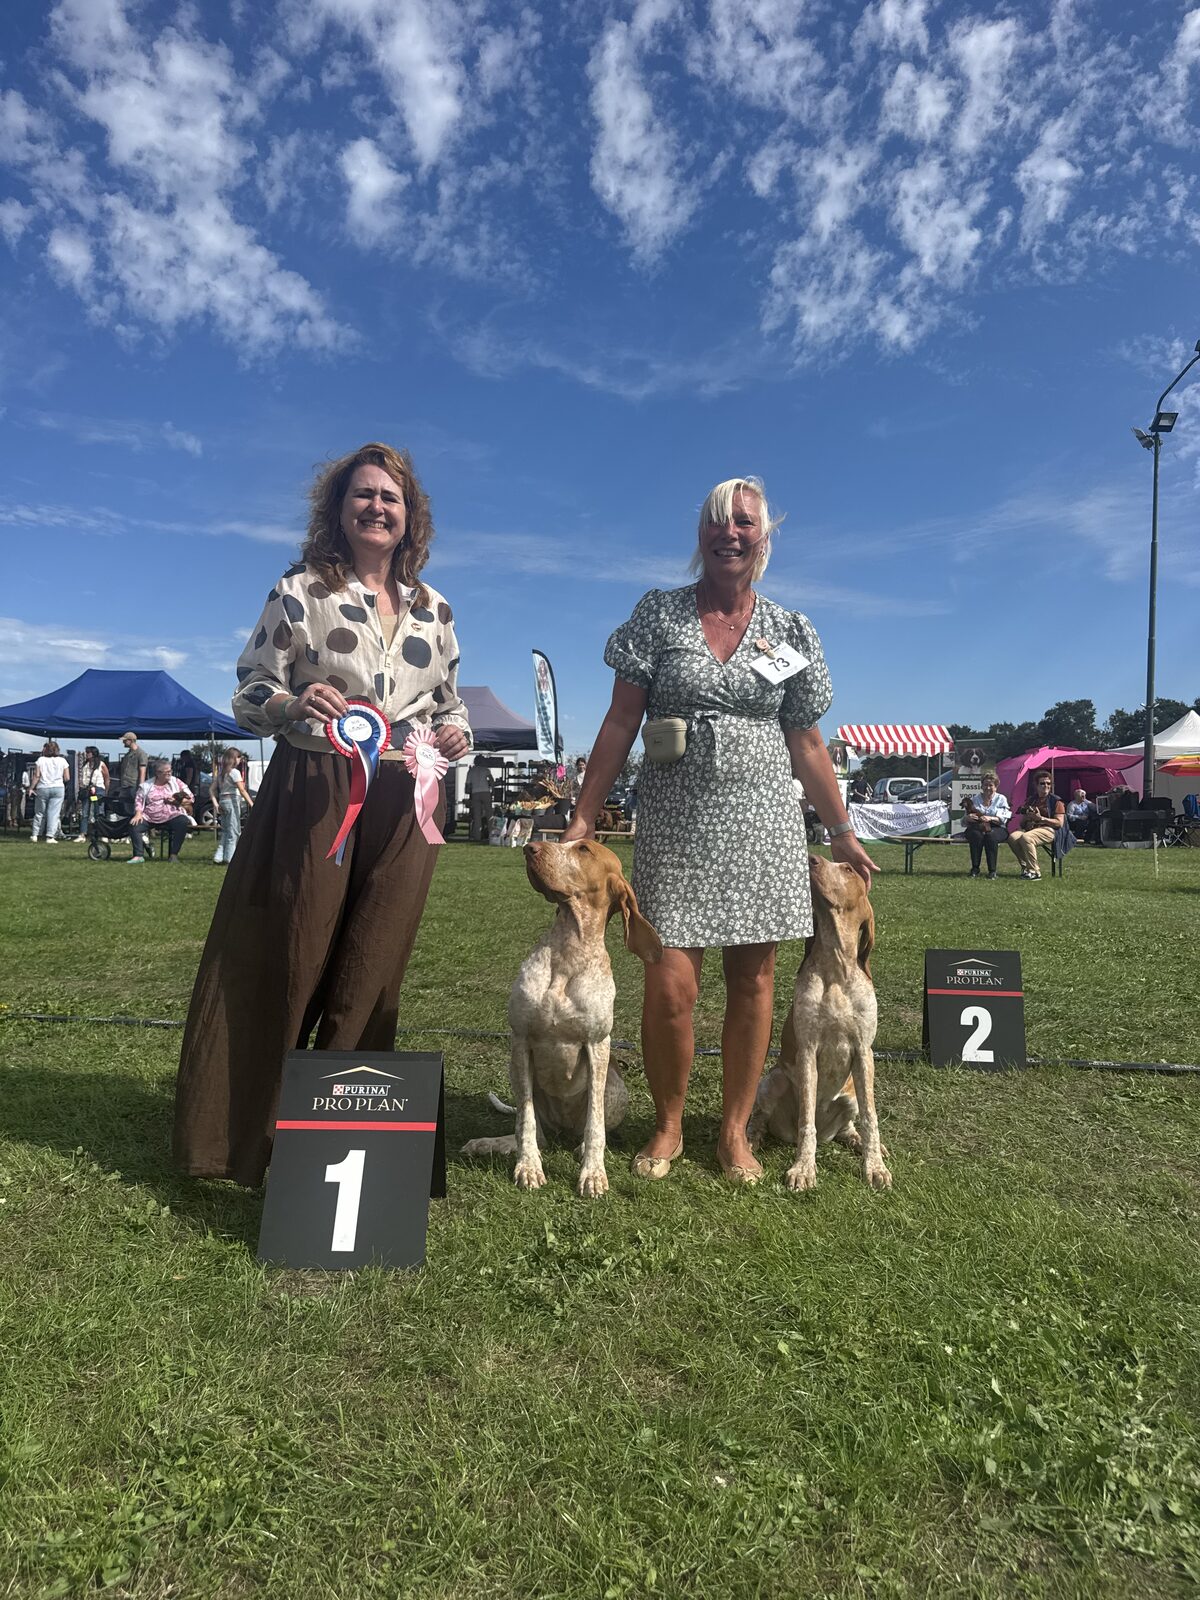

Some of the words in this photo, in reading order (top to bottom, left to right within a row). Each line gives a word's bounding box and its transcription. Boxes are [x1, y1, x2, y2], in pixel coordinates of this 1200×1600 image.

[768, 657, 790, 672] 73
[946, 976, 970, 985] PRO
[972, 977, 1002, 986] PLAN
[960, 1006, 994, 1062] 2
[344, 1086, 386, 1095] PURINA
[312, 1097, 351, 1111] PRO
[356, 1098, 406, 1112] PLAN
[324, 1149, 366, 1252] 1
